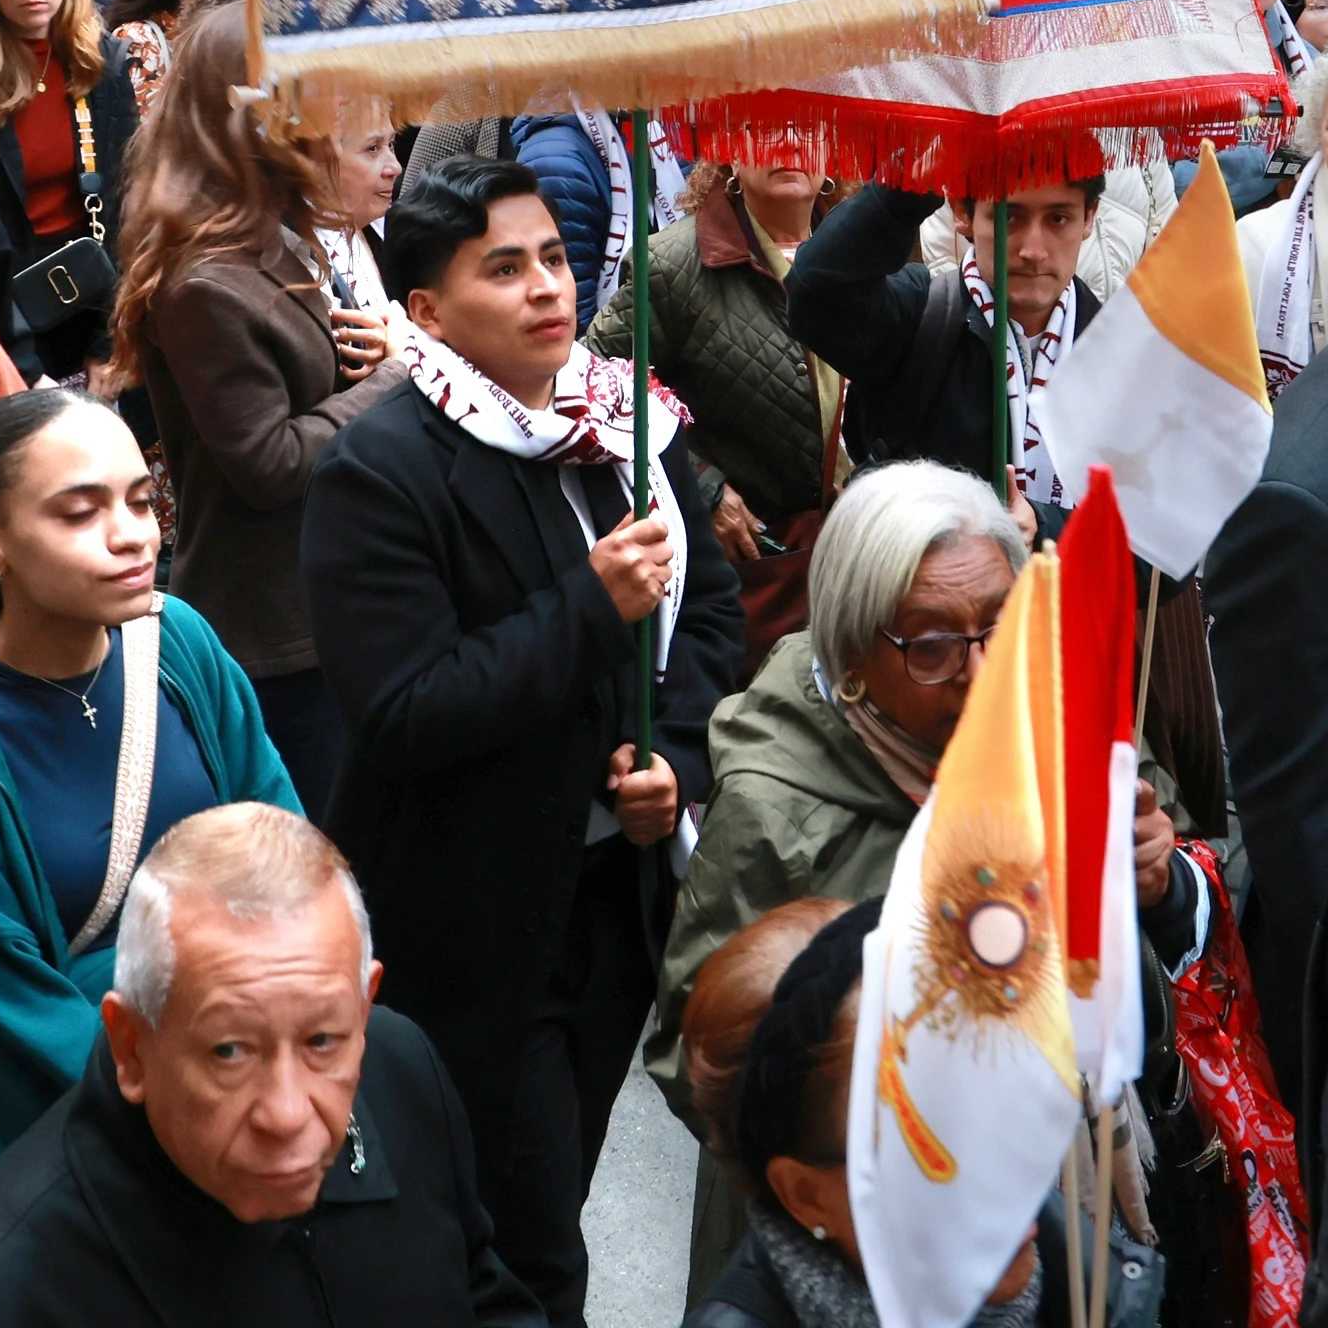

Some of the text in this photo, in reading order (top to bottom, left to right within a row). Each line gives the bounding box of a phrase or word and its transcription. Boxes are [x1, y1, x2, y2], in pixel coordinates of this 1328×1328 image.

[1291, 226, 1305, 244] THE
[1280, 283, 1293, 305] POPE
[1278, 304, 1288, 322] LEO
[1276, 322, 1286, 340] XIV
